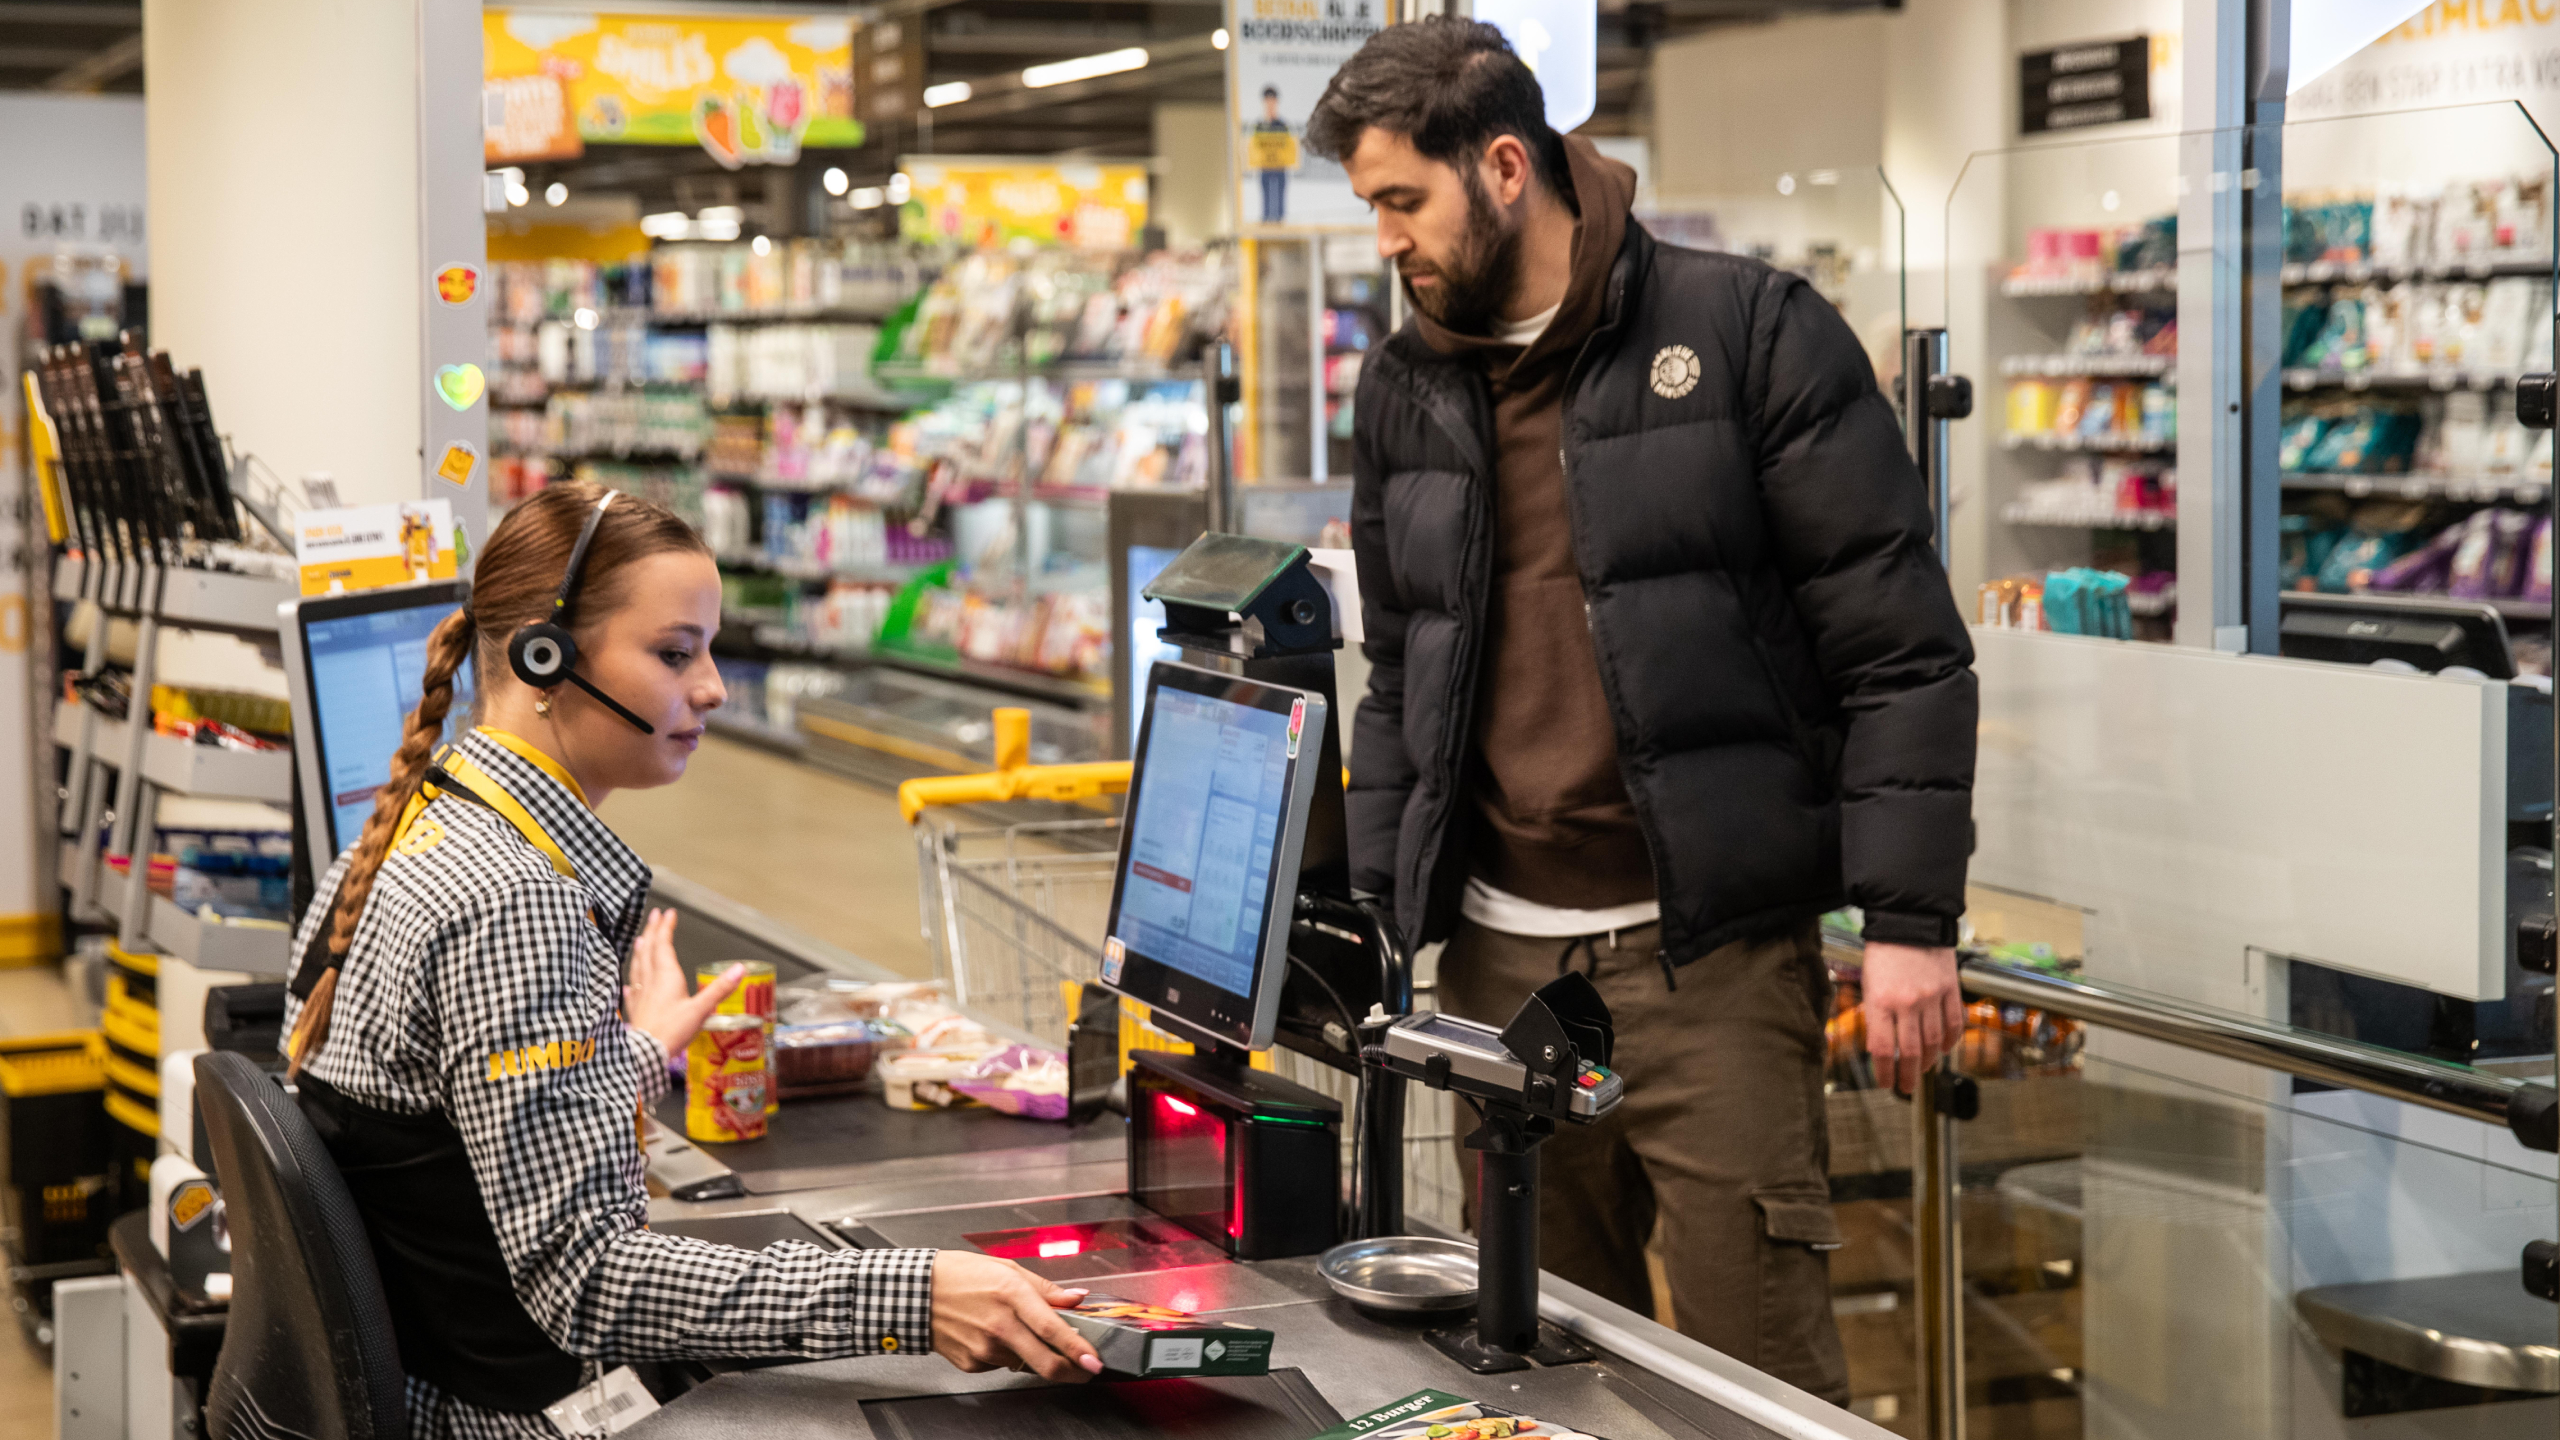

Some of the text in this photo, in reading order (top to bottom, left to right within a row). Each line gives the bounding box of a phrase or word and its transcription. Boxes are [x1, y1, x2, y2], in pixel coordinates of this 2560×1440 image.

[486, 1037, 595, 1081] JUMBO
[1349, 1394, 1435, 1432] 12 Burger
